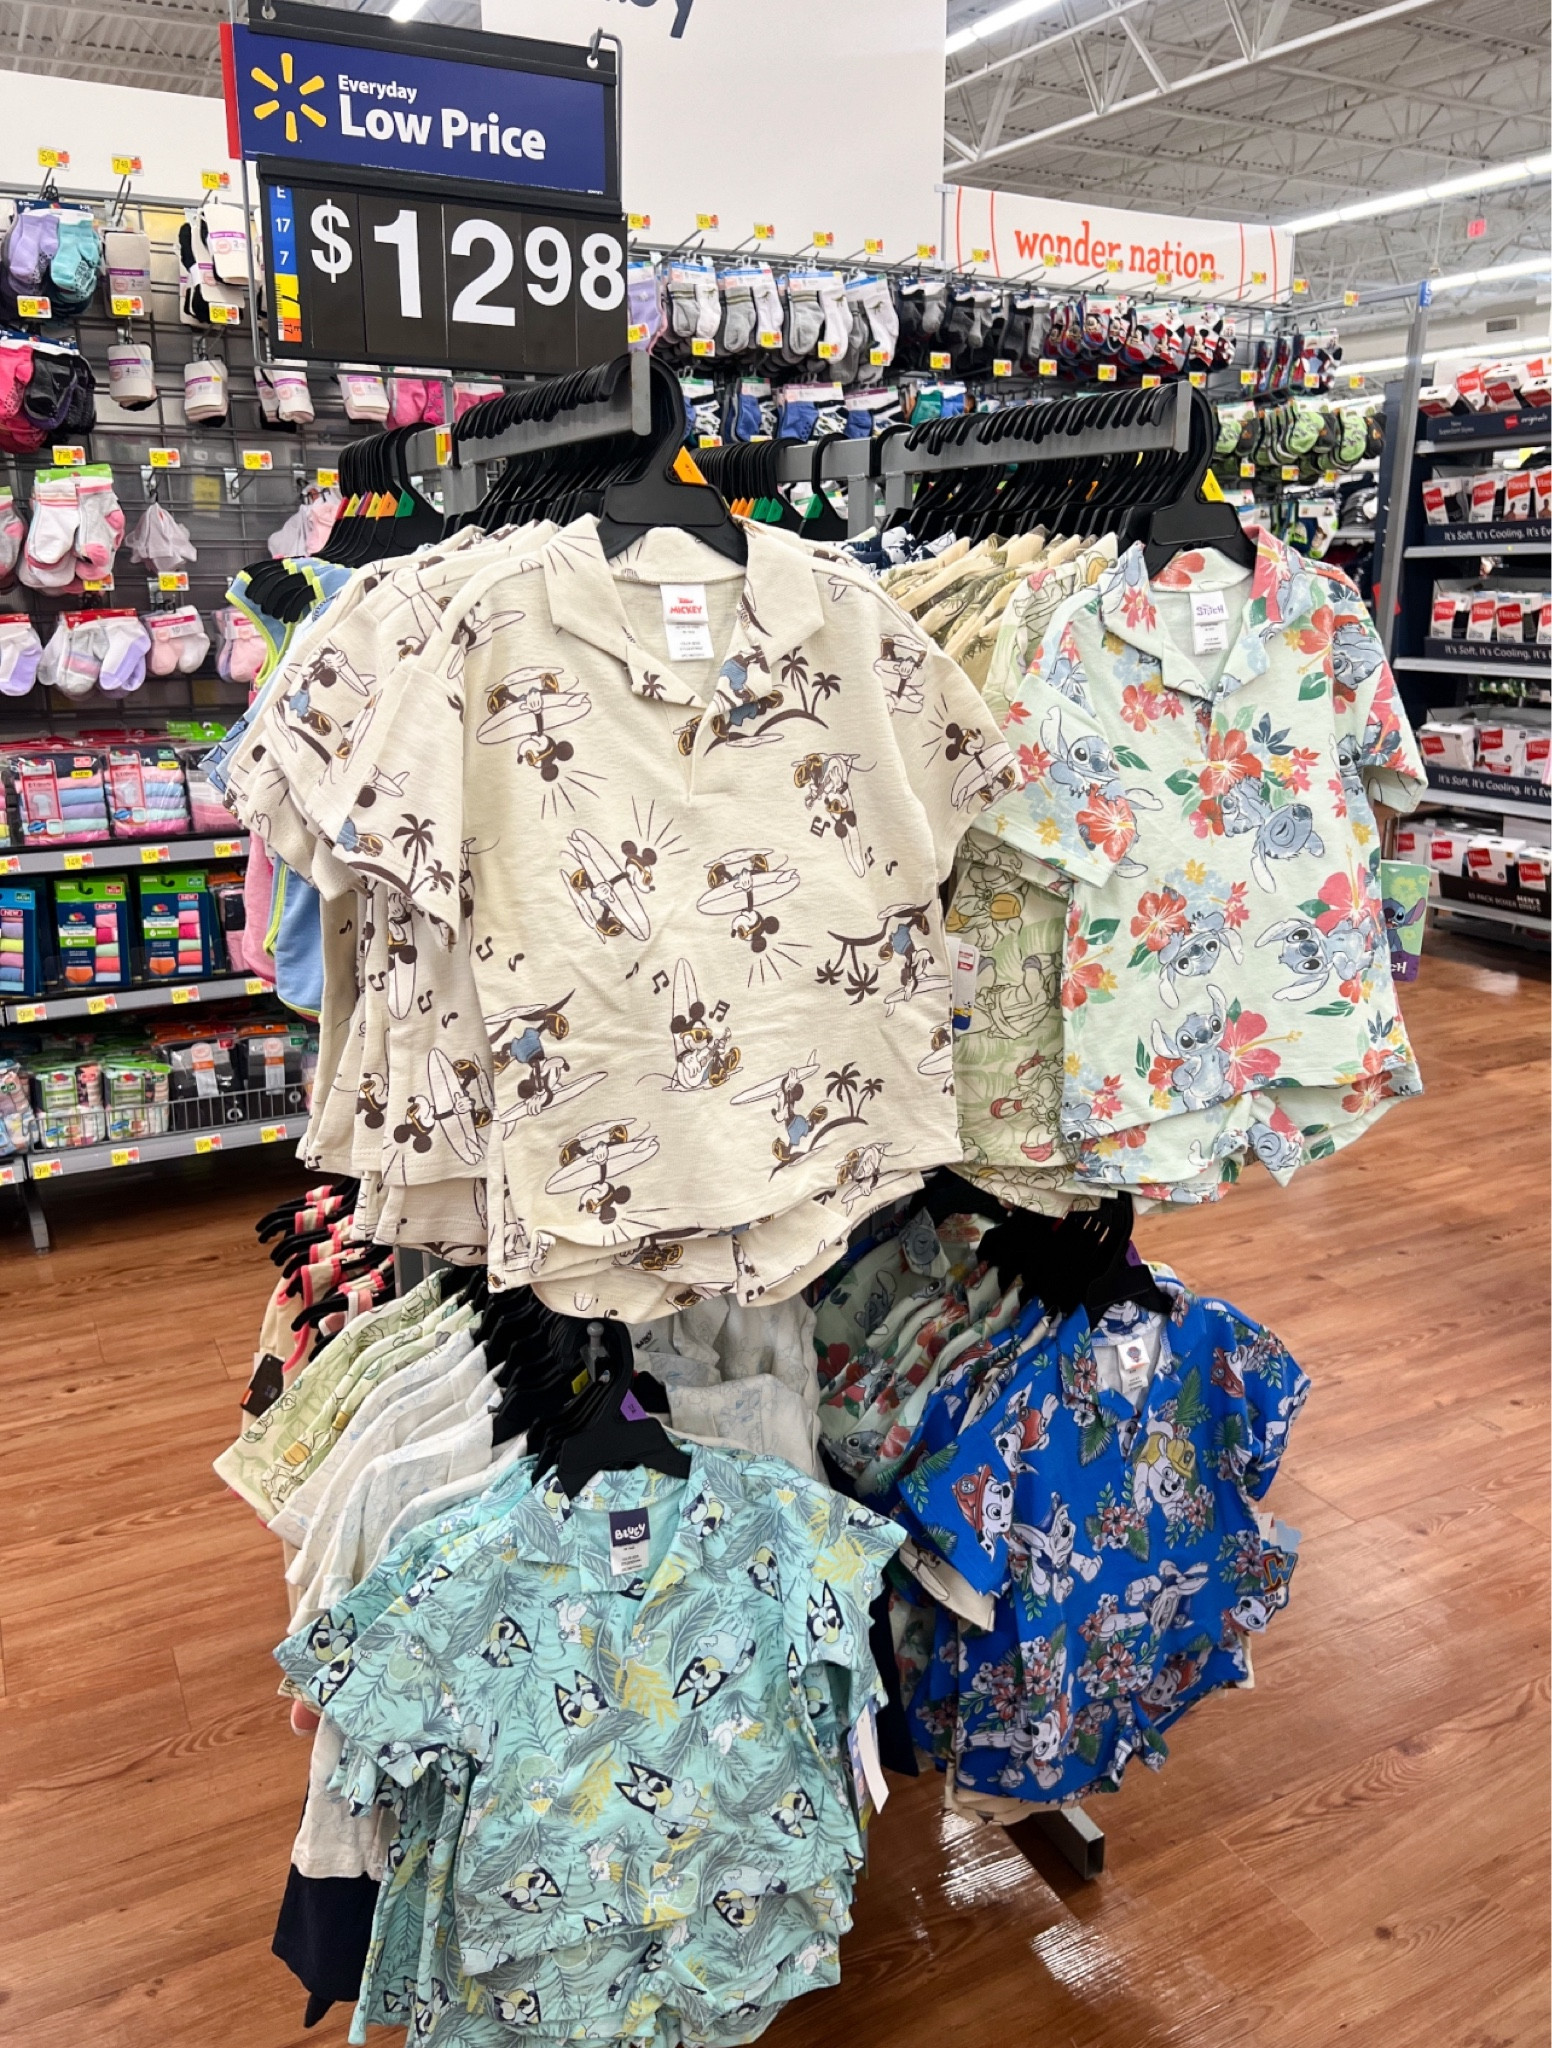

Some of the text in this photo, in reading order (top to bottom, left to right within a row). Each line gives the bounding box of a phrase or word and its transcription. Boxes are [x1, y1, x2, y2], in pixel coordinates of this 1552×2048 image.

[338, 74, 417, 103] Everyday
[339, 94, 546, 161] Low Price
[275, 217, 291, 233] 17
[279, 250, 289, 266] 7
[1014, 220, 1215, 280] wonder nation
[670, 605, 703, 615] MICKEY
